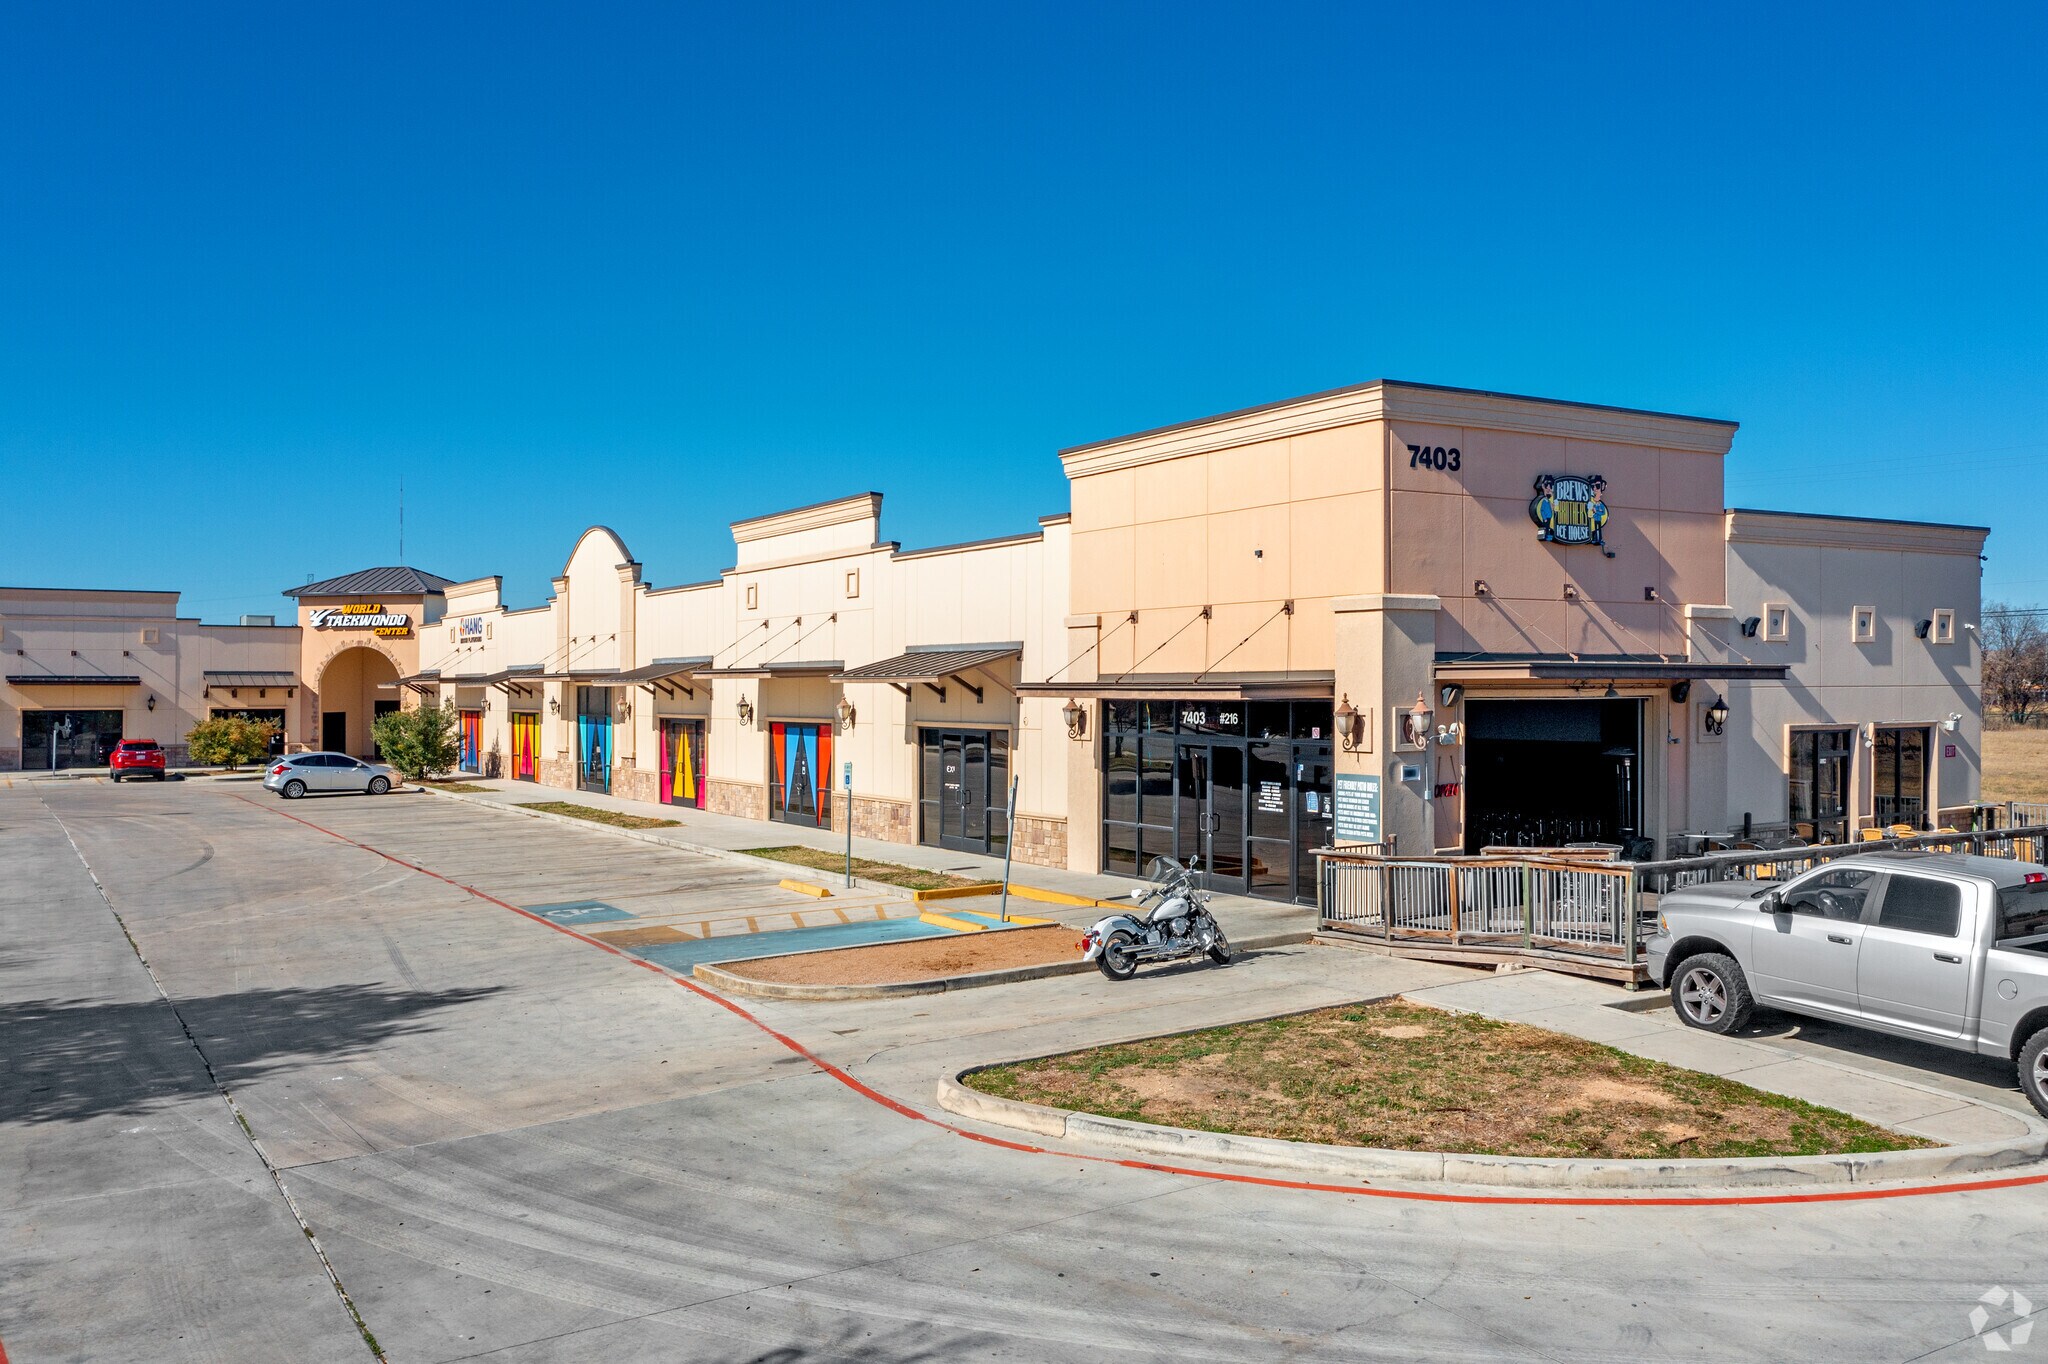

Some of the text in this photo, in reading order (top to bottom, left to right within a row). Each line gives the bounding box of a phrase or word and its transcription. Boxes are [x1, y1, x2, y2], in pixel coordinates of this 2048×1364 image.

[1407, 444, 1461, 472] 7403
[1556, 480, 1588, 502] BREWS
[1556, 525, 1589, 541] ICE HOUSE
[342, 604, 381, 615] WORLD
[326, 614, 408, 627] TAEKWONDO
[374, 627, 409, 636] CENTER
[1182, 711, 1239, 725] 7403 #216
